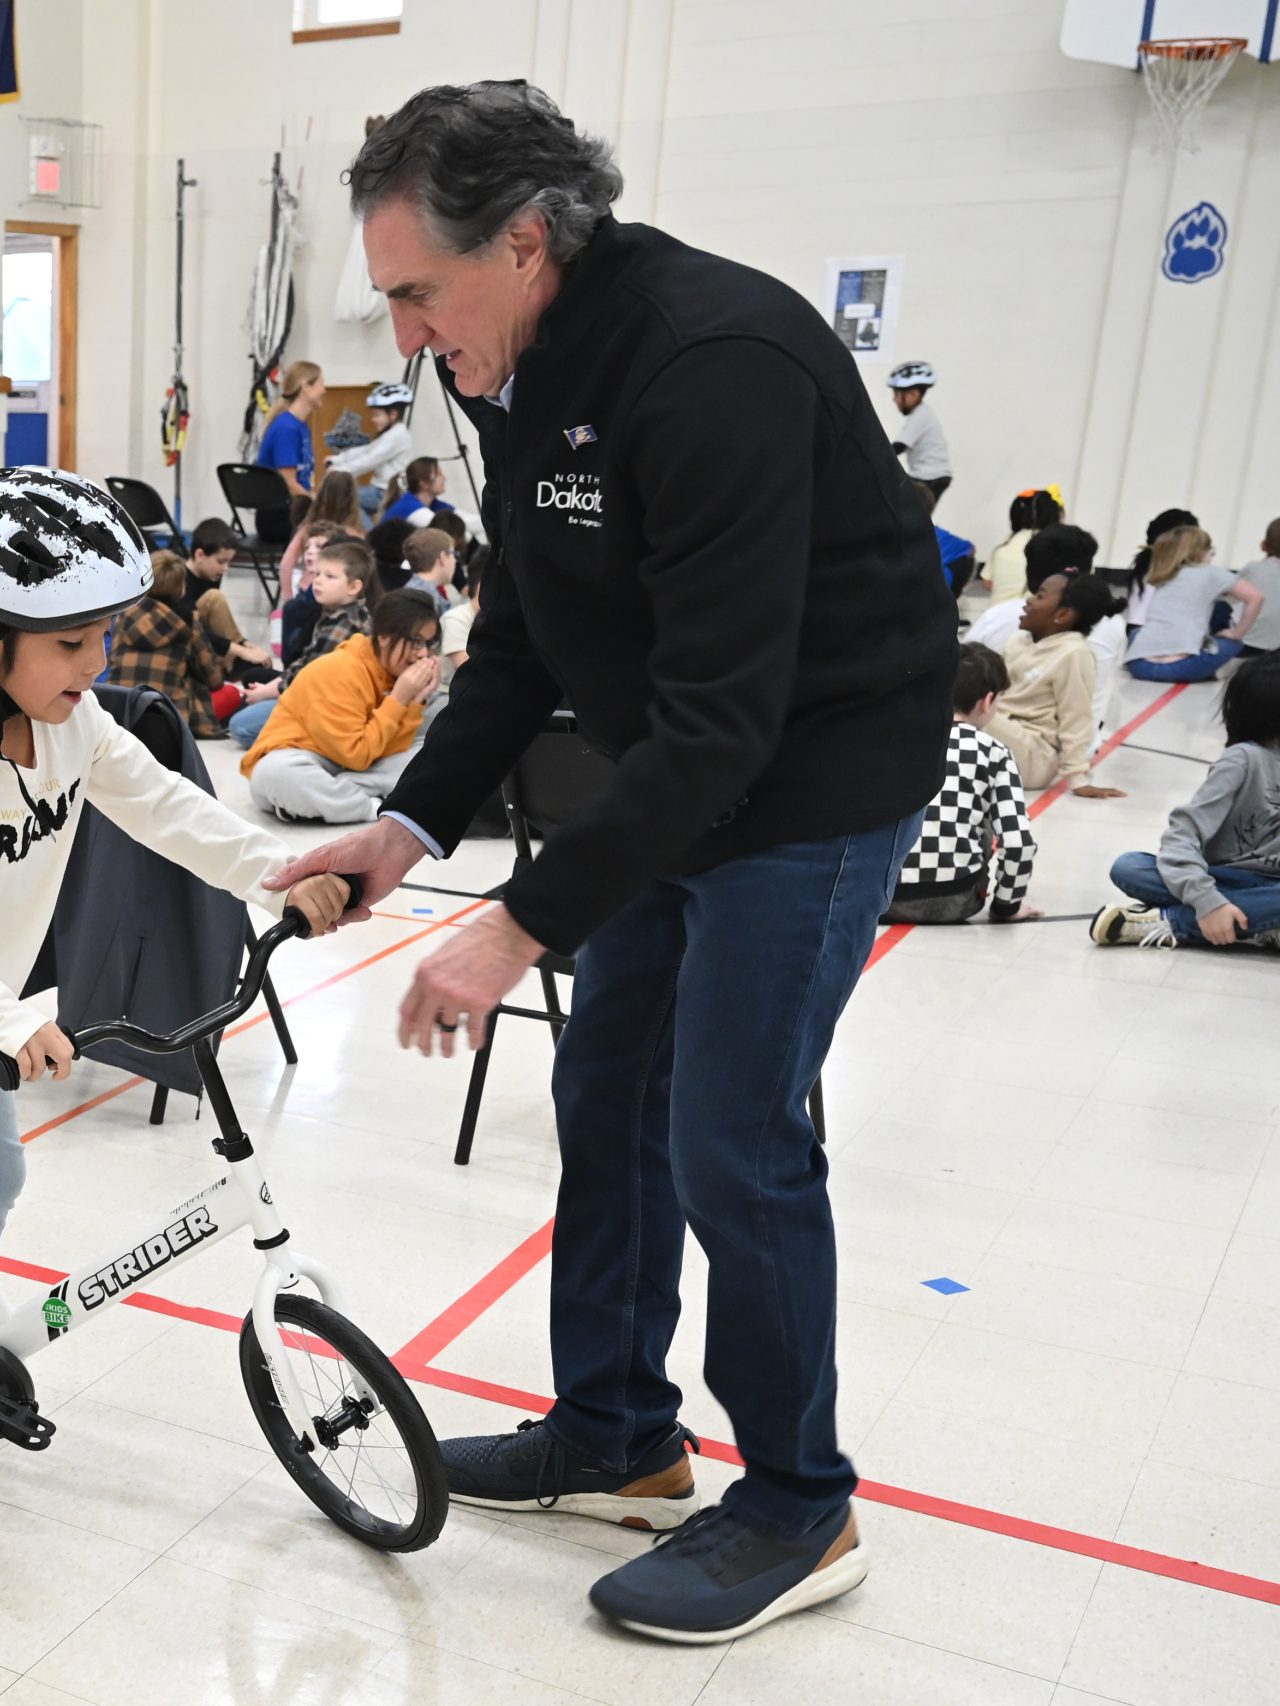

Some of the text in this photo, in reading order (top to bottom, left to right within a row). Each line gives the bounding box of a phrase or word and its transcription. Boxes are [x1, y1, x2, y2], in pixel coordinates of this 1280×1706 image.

[555, 473, 600, 485] NORTH
[78, 1206, 219, 1311] STRIDER
[49, 1303, 68, 1314] KIDS
[45, 1312, 69, 1323] BIKE
